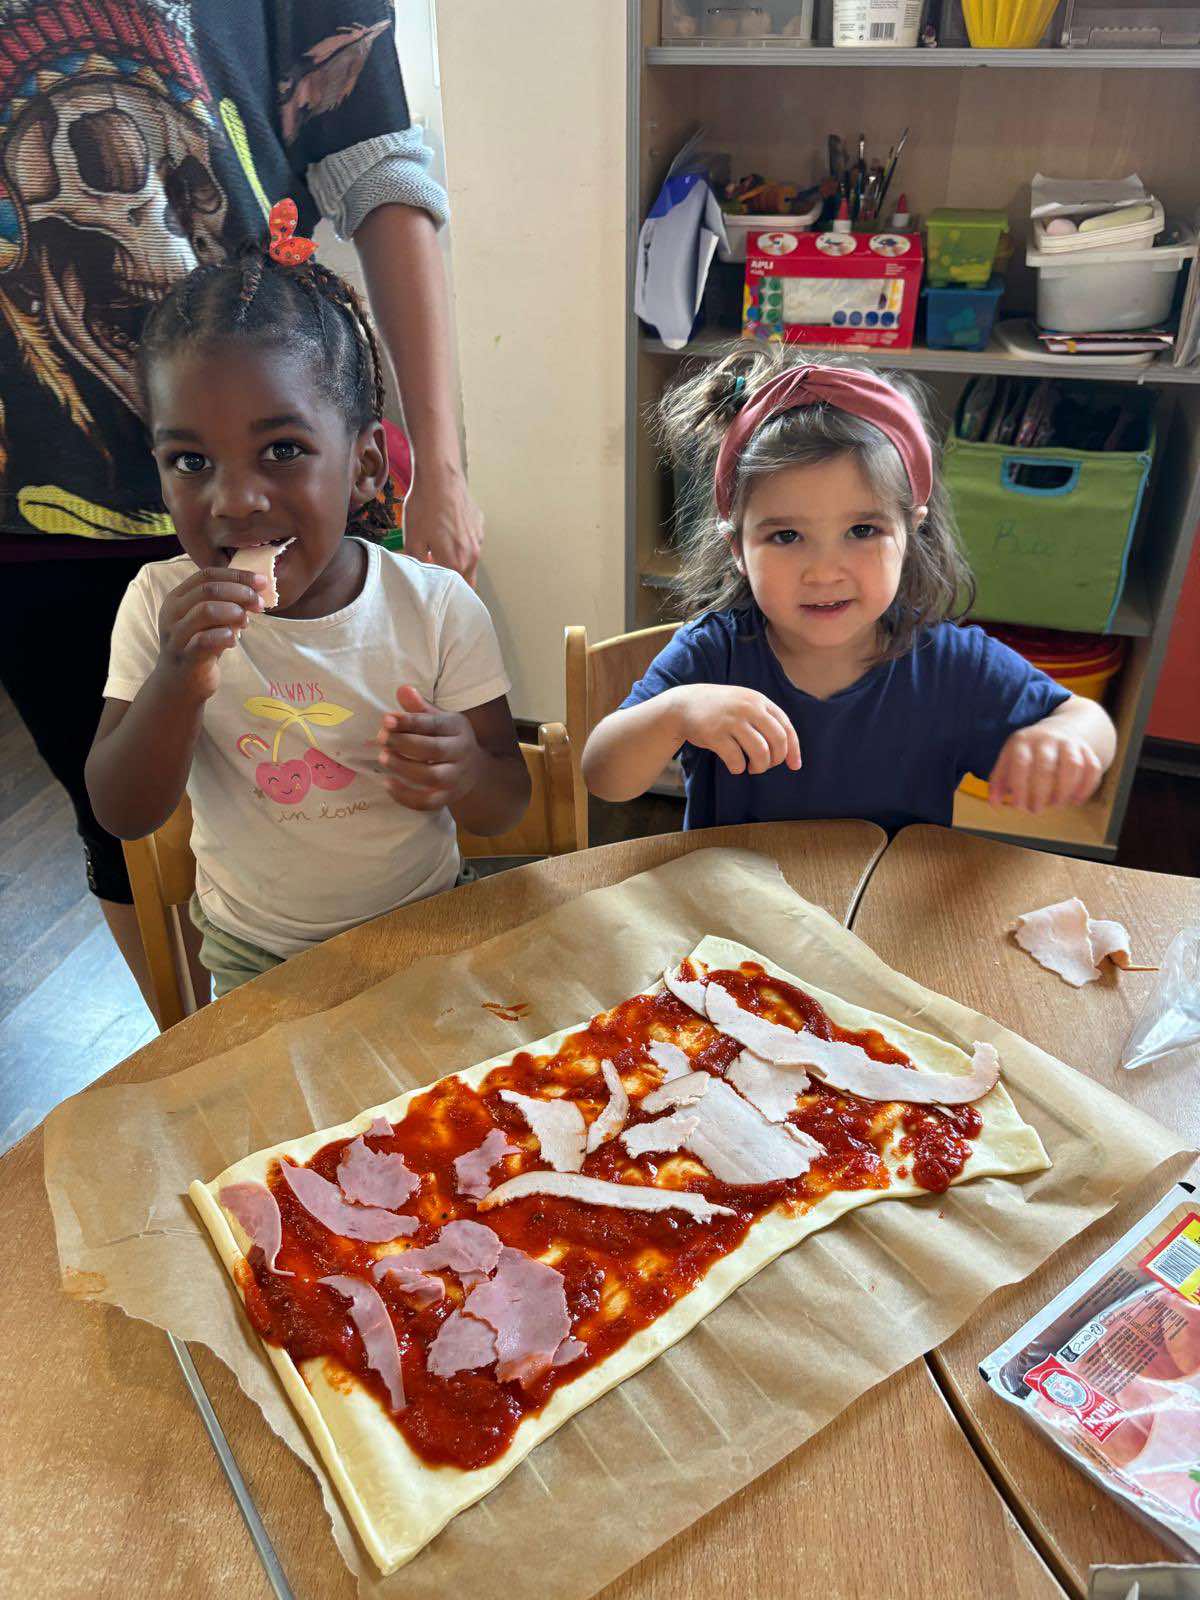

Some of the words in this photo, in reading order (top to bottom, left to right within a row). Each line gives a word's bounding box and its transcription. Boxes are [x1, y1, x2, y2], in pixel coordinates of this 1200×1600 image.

[270, 681, 325, 702] ALWAYS
[279, 811, 311, 823] in
[319, 802, 369, 819] love
